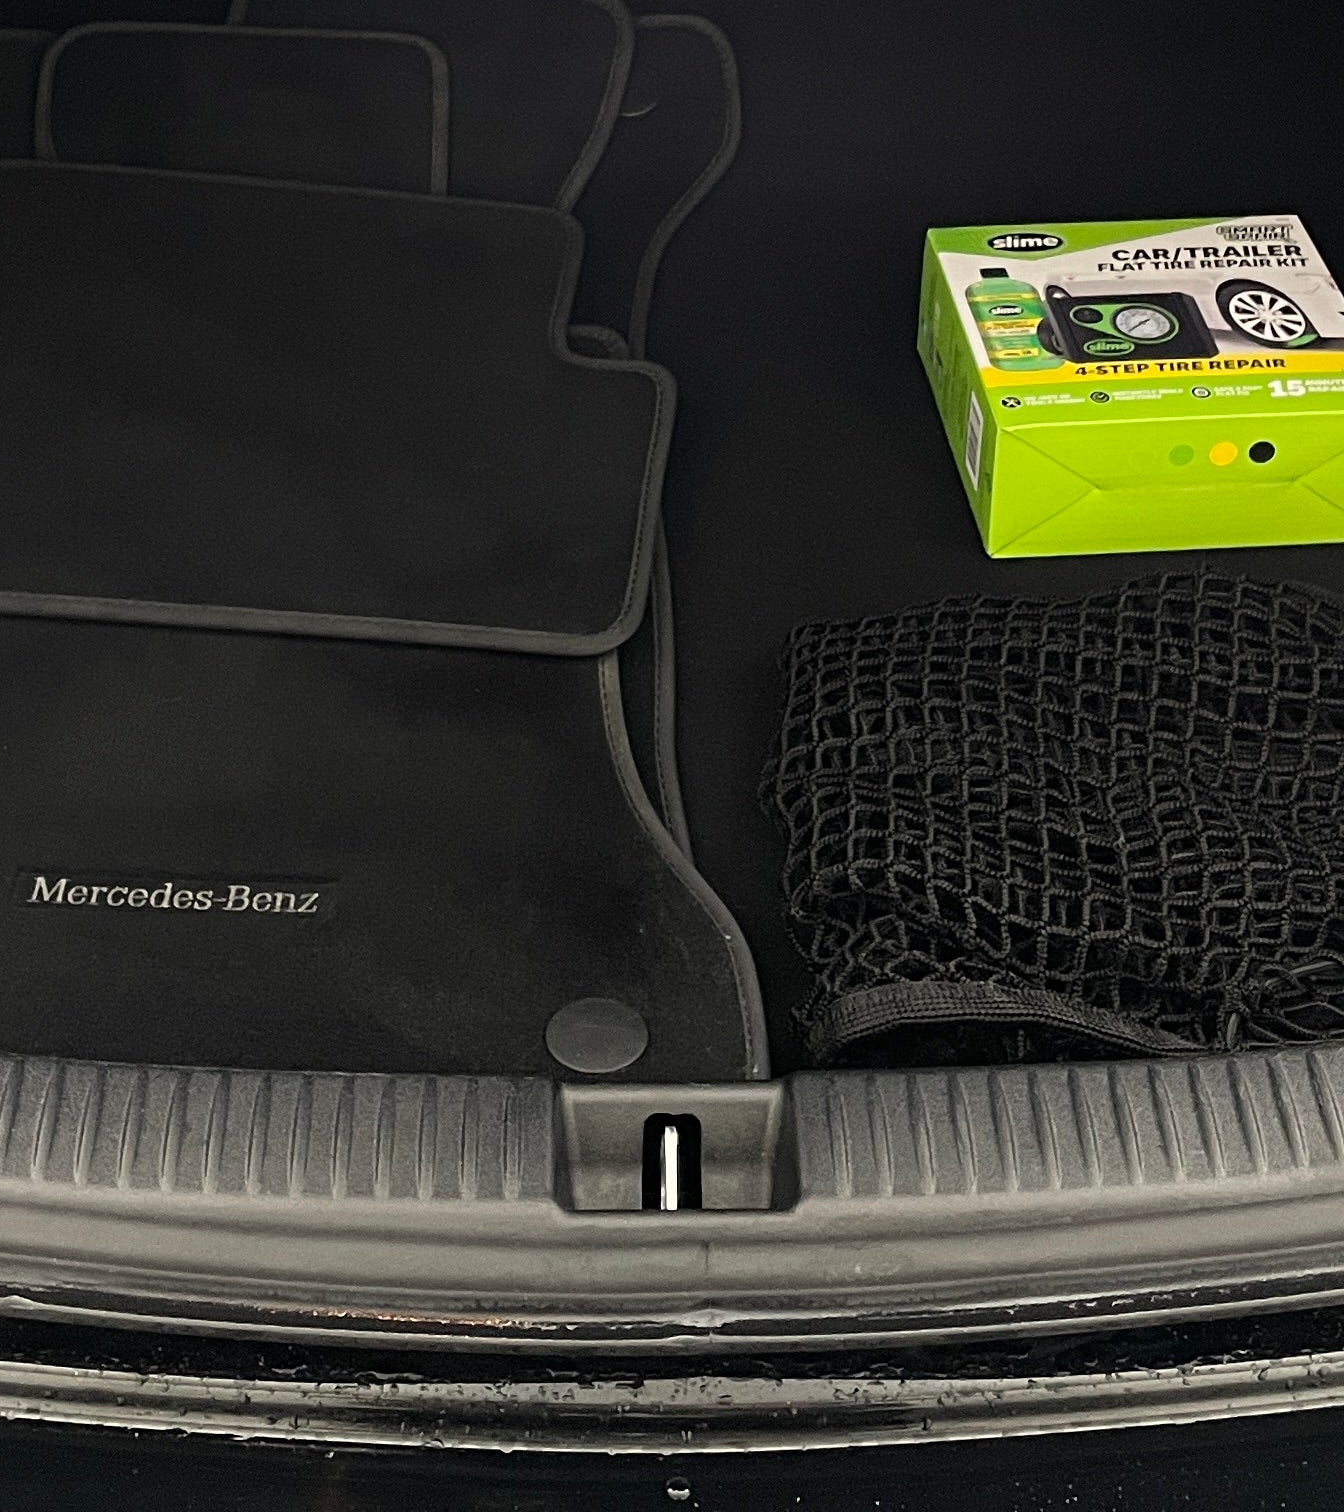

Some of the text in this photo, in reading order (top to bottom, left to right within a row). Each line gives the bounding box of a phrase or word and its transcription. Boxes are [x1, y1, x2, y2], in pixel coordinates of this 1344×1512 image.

[992, 235, 1059, 249] slime
[1111, 244, 1303, 262] CAR/TRAILER
[1097, 257, 1310, 272] FLAT TIRE REPAIR KIT
[1074, 358, 1287, 376] 4-STEP TIRE REPAIR
[1267, 379, 1306, 398] 15
[26, 876, 320, 914] Mercedes-Benz
